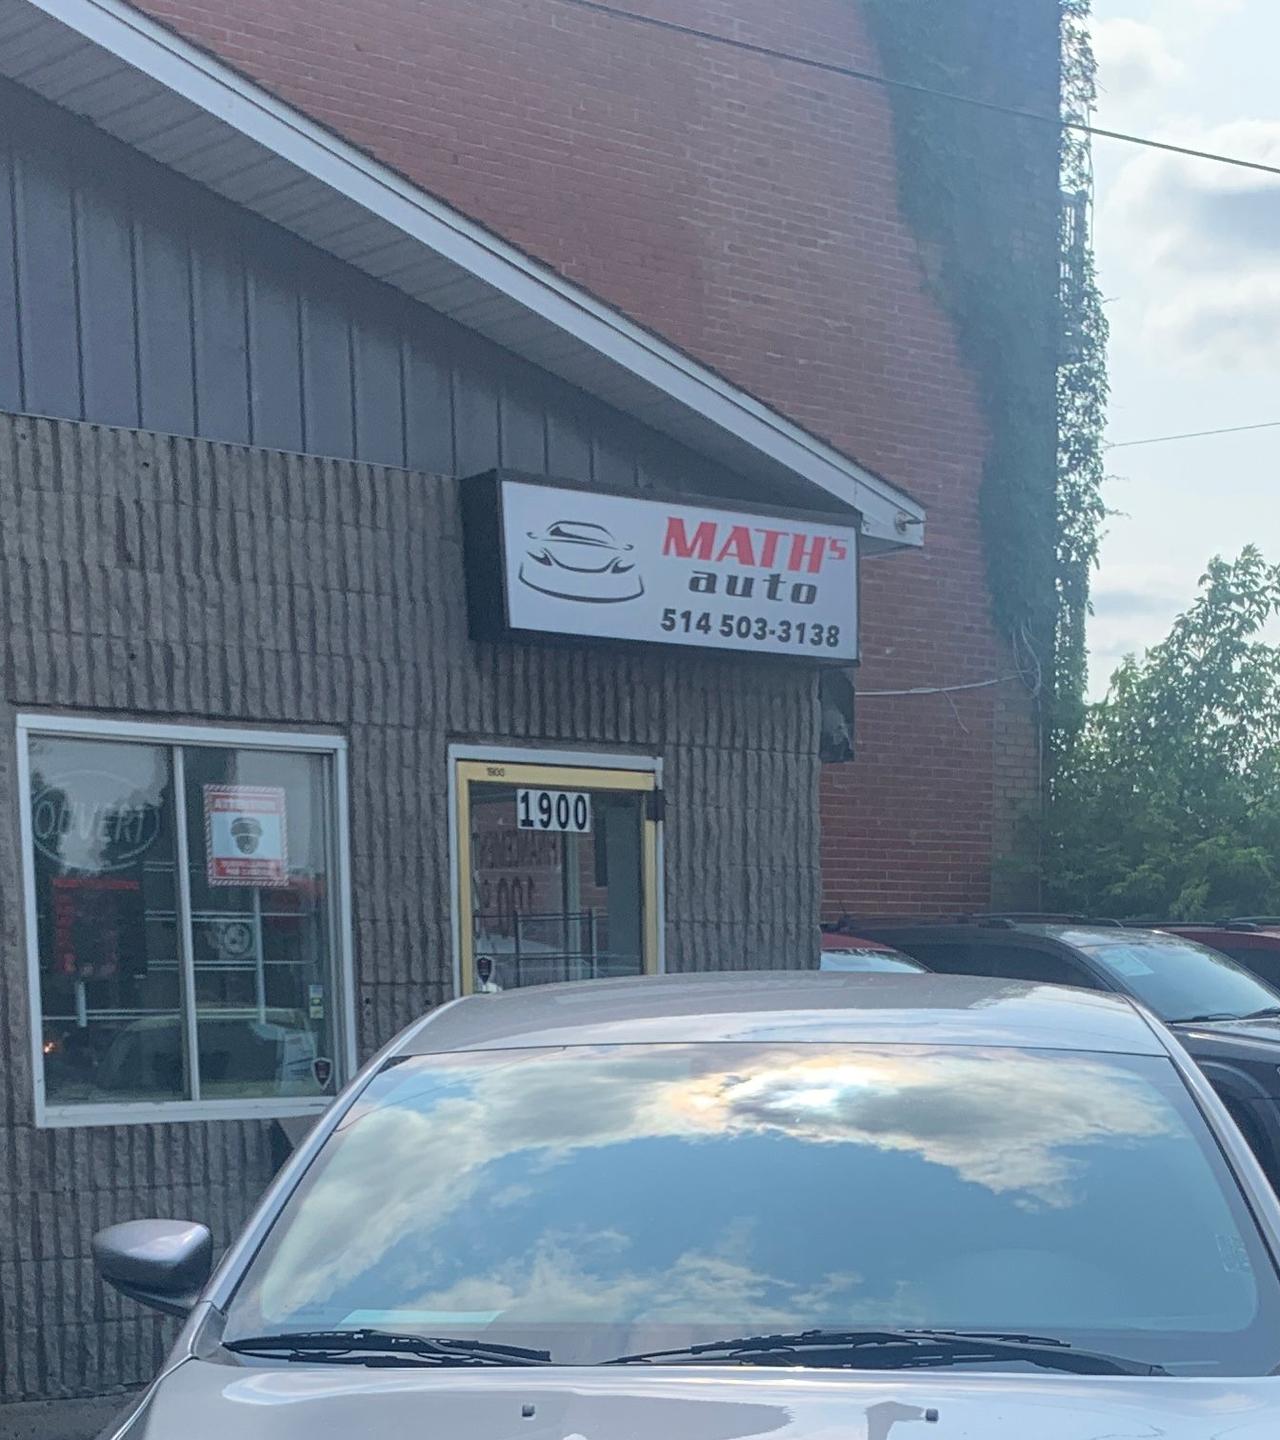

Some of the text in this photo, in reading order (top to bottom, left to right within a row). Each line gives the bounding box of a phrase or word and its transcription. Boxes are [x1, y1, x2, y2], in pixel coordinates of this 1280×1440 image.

[688, 570, 818, 605] auto
[661, 608, 840, 648] 514 503-3138
[520, 791, 587, 831] 1900
